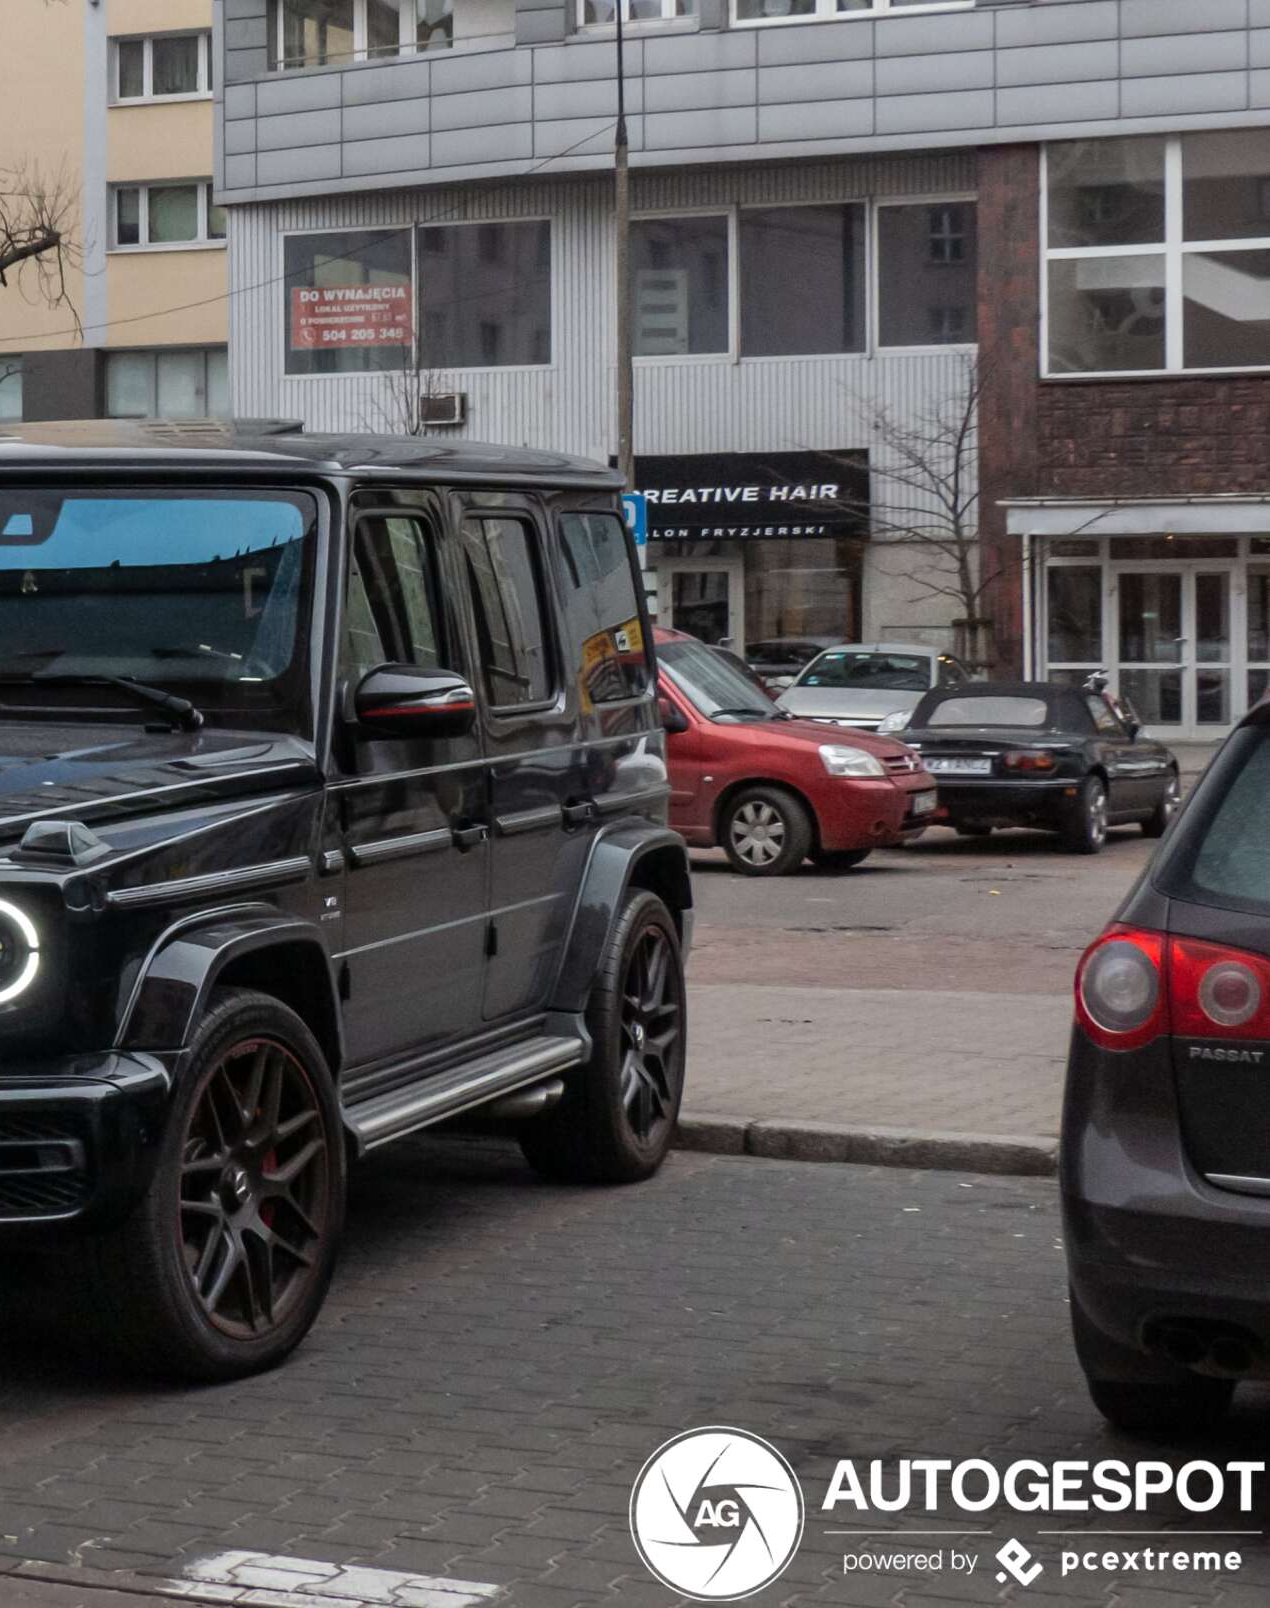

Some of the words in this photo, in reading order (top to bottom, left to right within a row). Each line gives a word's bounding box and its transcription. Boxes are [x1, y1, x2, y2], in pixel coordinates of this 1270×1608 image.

[300, 291, 320, 302] DO
[323, 287, 406, 301] WYNAJĘCIA
[322, 329, 347, 341] 504
[350, 328, 375, 340] 205
[633, 486, 759, 504] REATIVE
[770, 484, 839, 500] HAIR
[646, 529, 688, 538] LON
[701, 526, 825, 537] FRYZJERSKI
[1189, 1046, 1265, 1063] PASSAT
